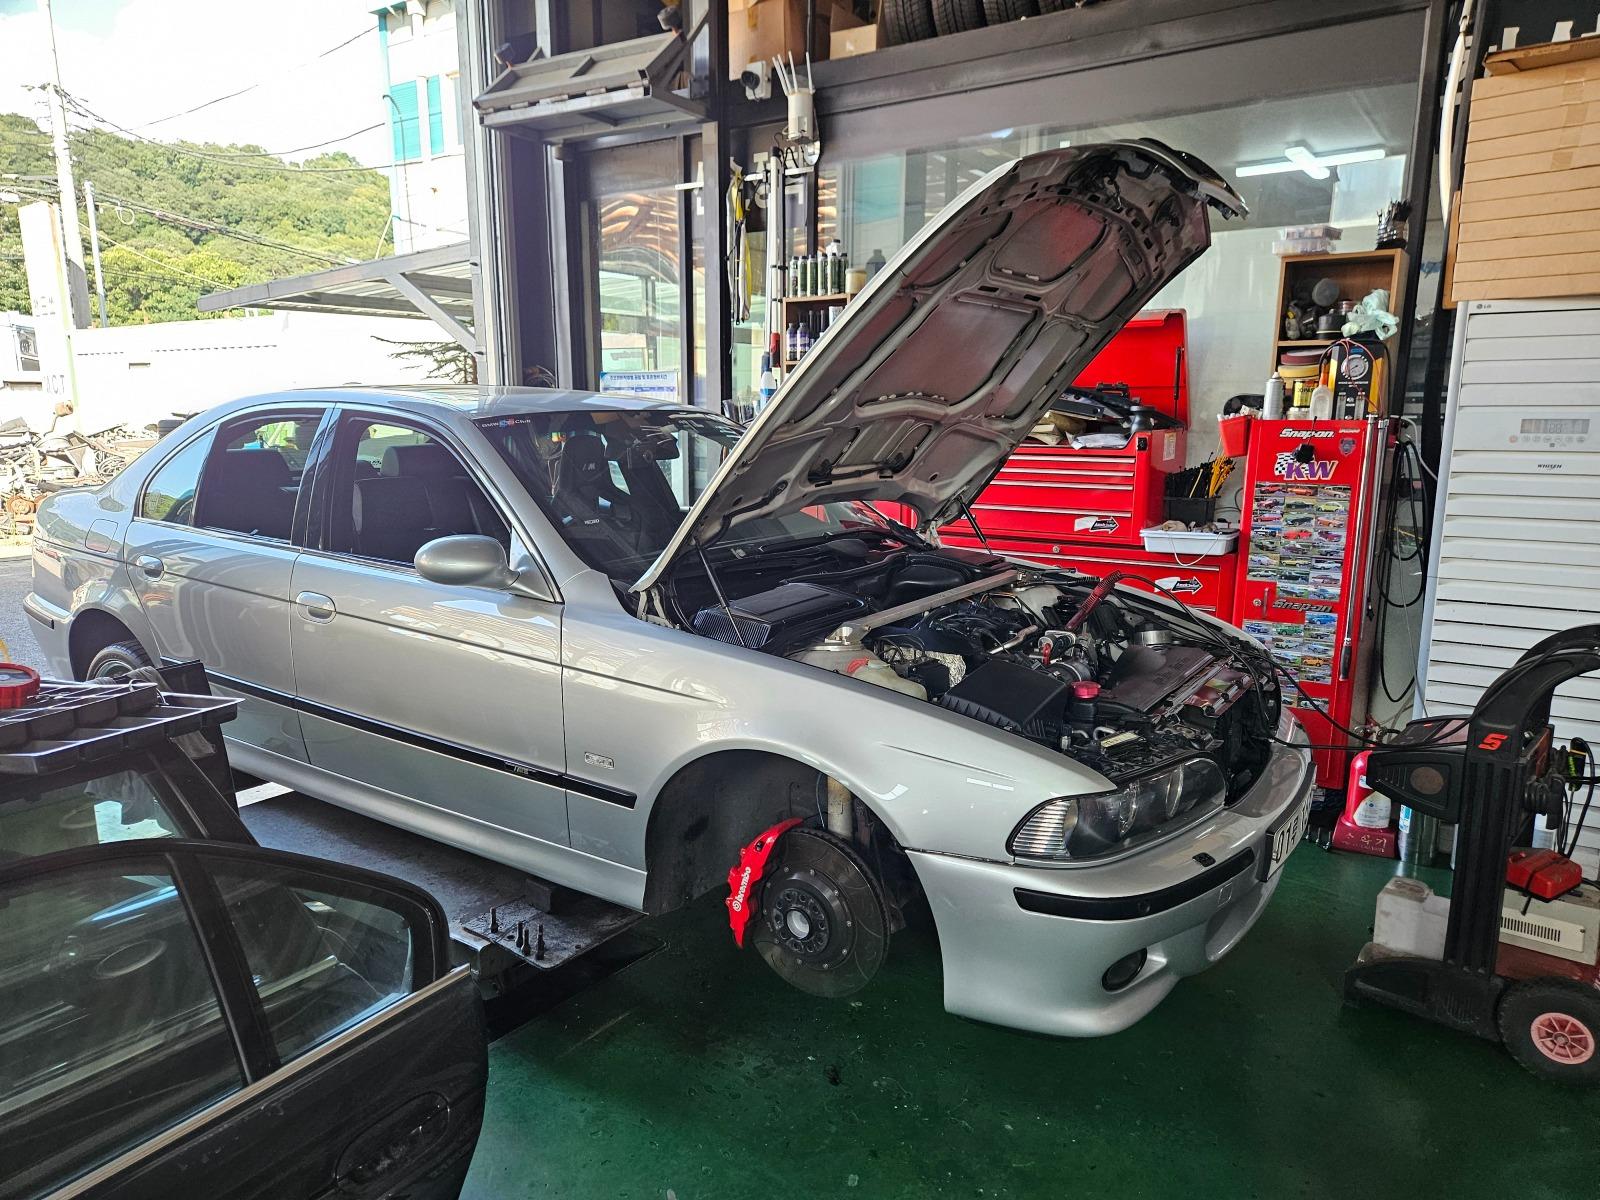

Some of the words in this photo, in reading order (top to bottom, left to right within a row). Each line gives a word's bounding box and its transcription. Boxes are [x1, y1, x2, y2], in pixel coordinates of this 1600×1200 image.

[1280, 428, 1334, 439] Snap-on
[1284, 460, 1339, 481] KW
[1272, 599, 1333, 613] Snap-on
[734, 866, 751, 904] brembo
